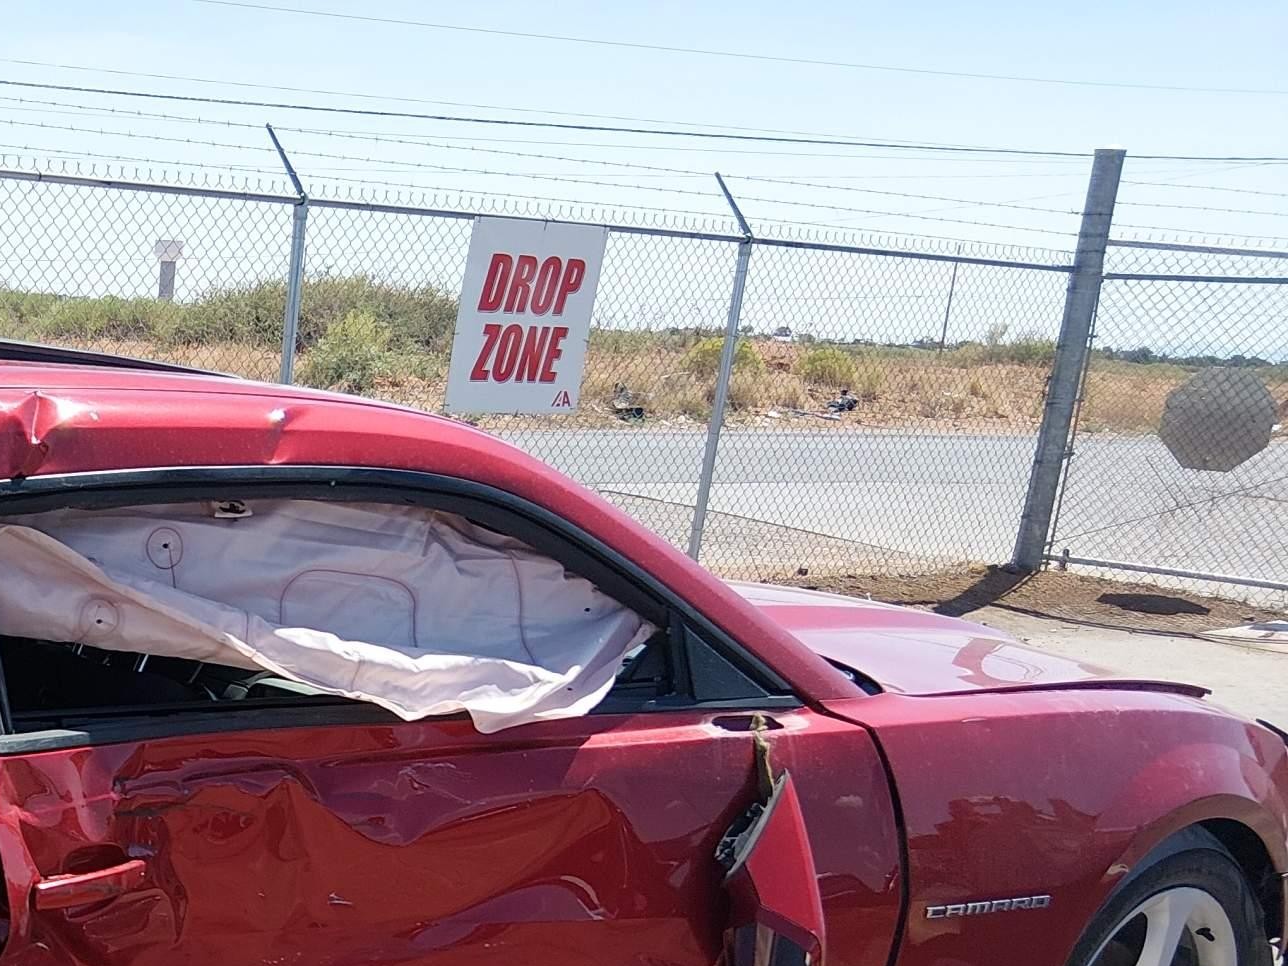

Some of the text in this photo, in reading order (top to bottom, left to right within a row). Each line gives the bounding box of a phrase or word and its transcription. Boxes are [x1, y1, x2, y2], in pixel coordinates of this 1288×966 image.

[477, 253, 586, 315] DROP
[470, 324, 569, 383] ZONE
[925, 895, 1052, 919] CAMARO
